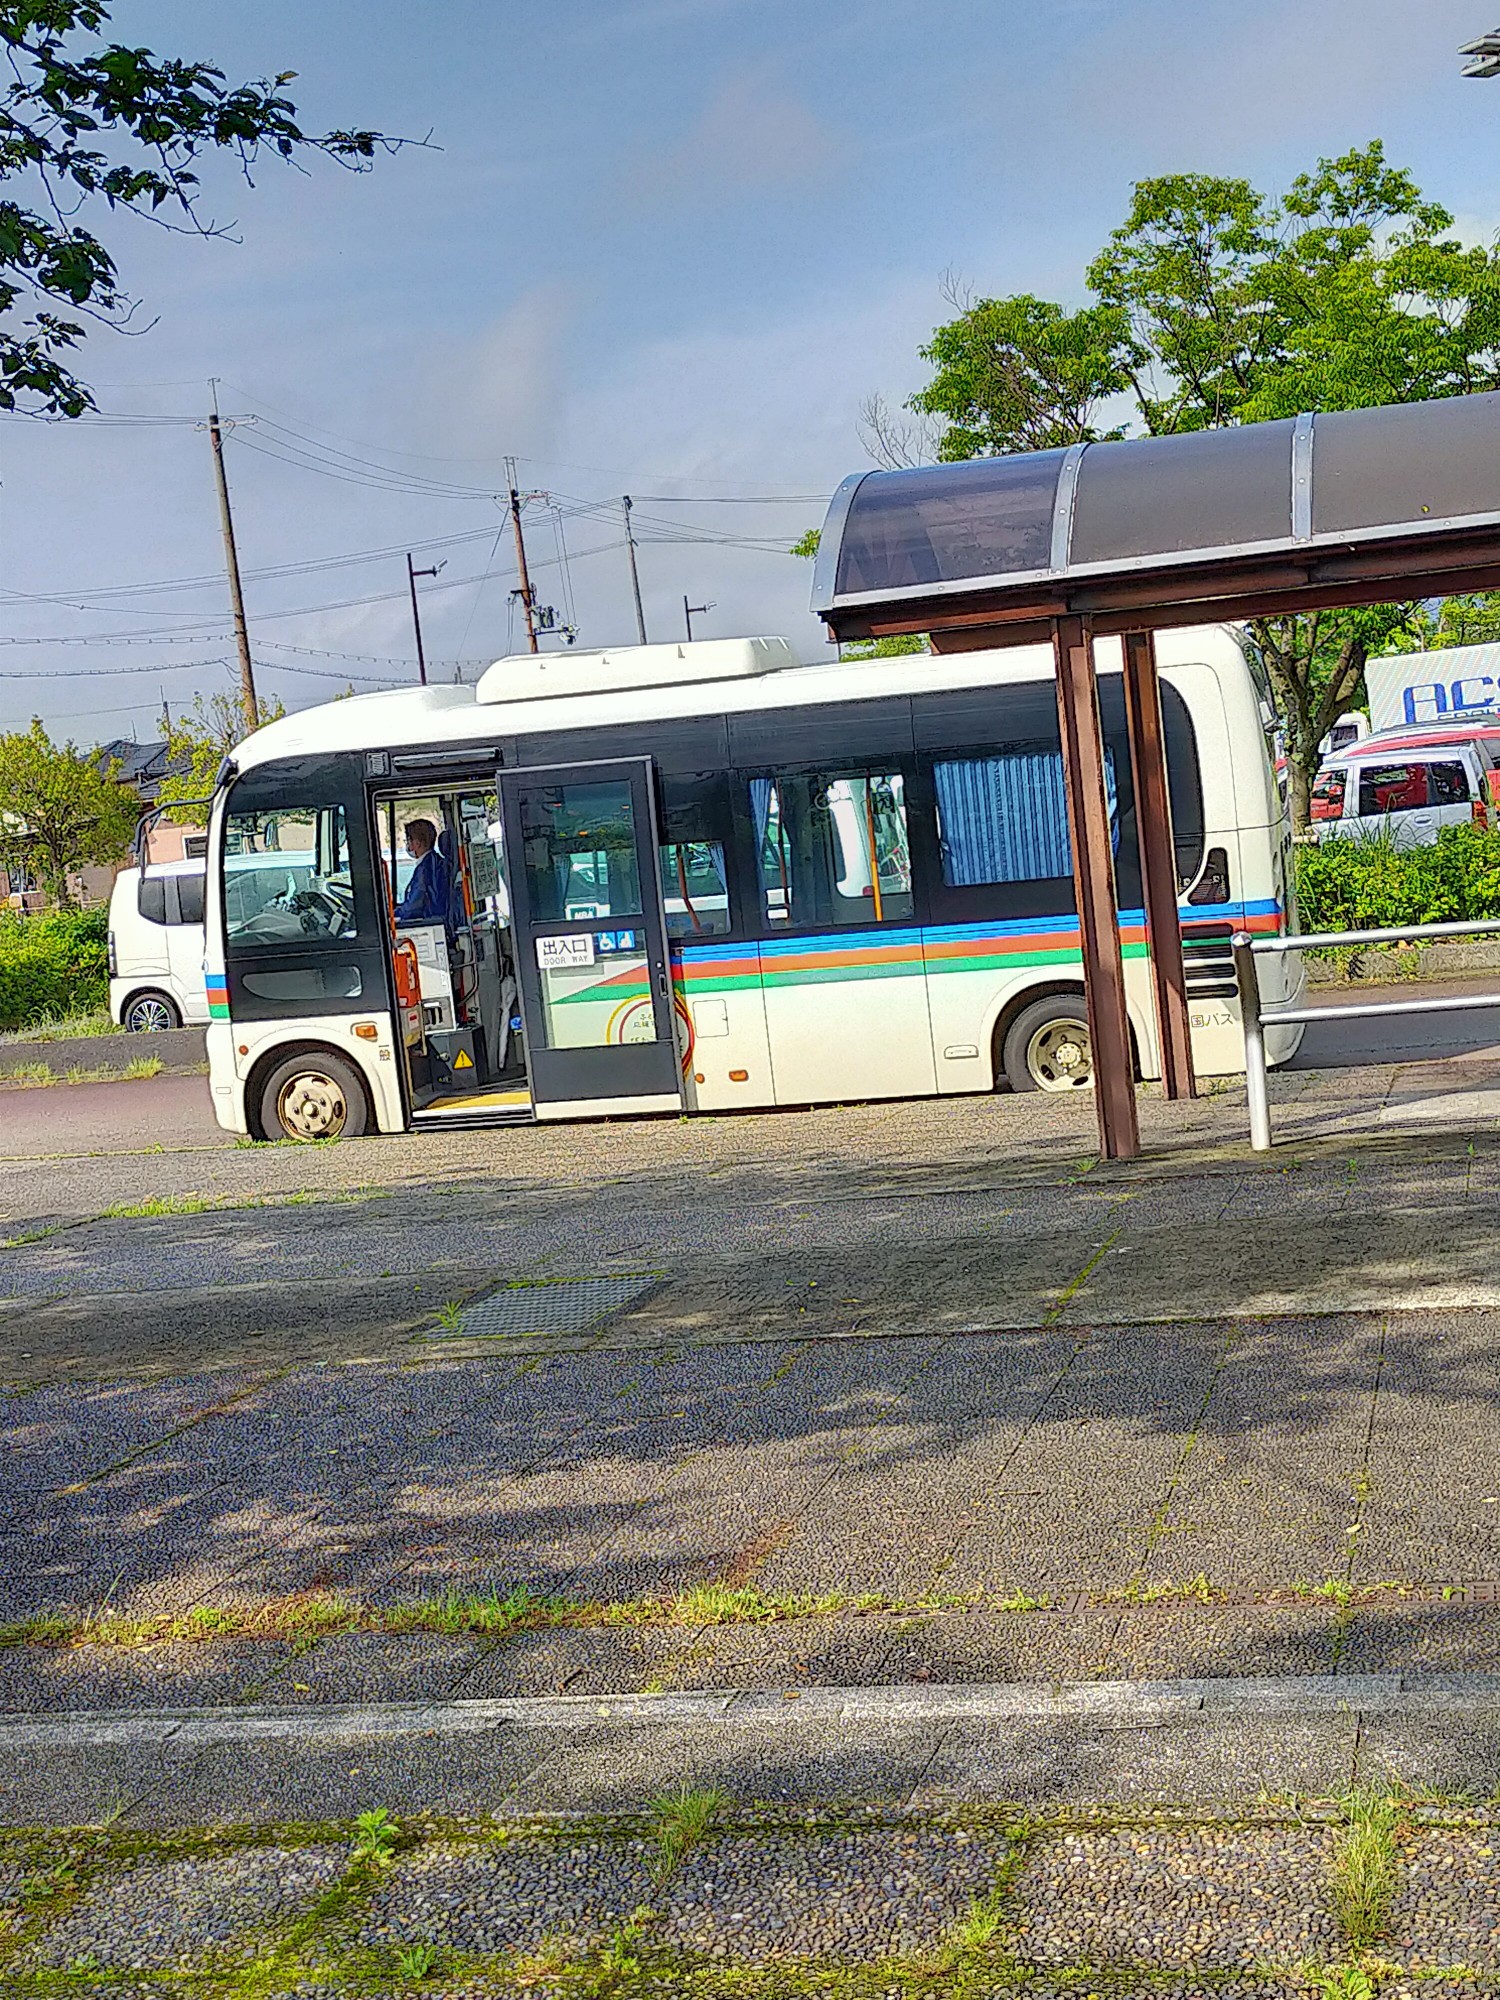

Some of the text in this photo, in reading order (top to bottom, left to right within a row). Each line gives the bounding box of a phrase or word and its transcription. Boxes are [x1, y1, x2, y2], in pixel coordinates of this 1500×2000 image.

[1403, 677, 1500, 724] AC
[543, 938, 587, 955] 出入口
[544, 955, 588, 965] DOOR WAY
